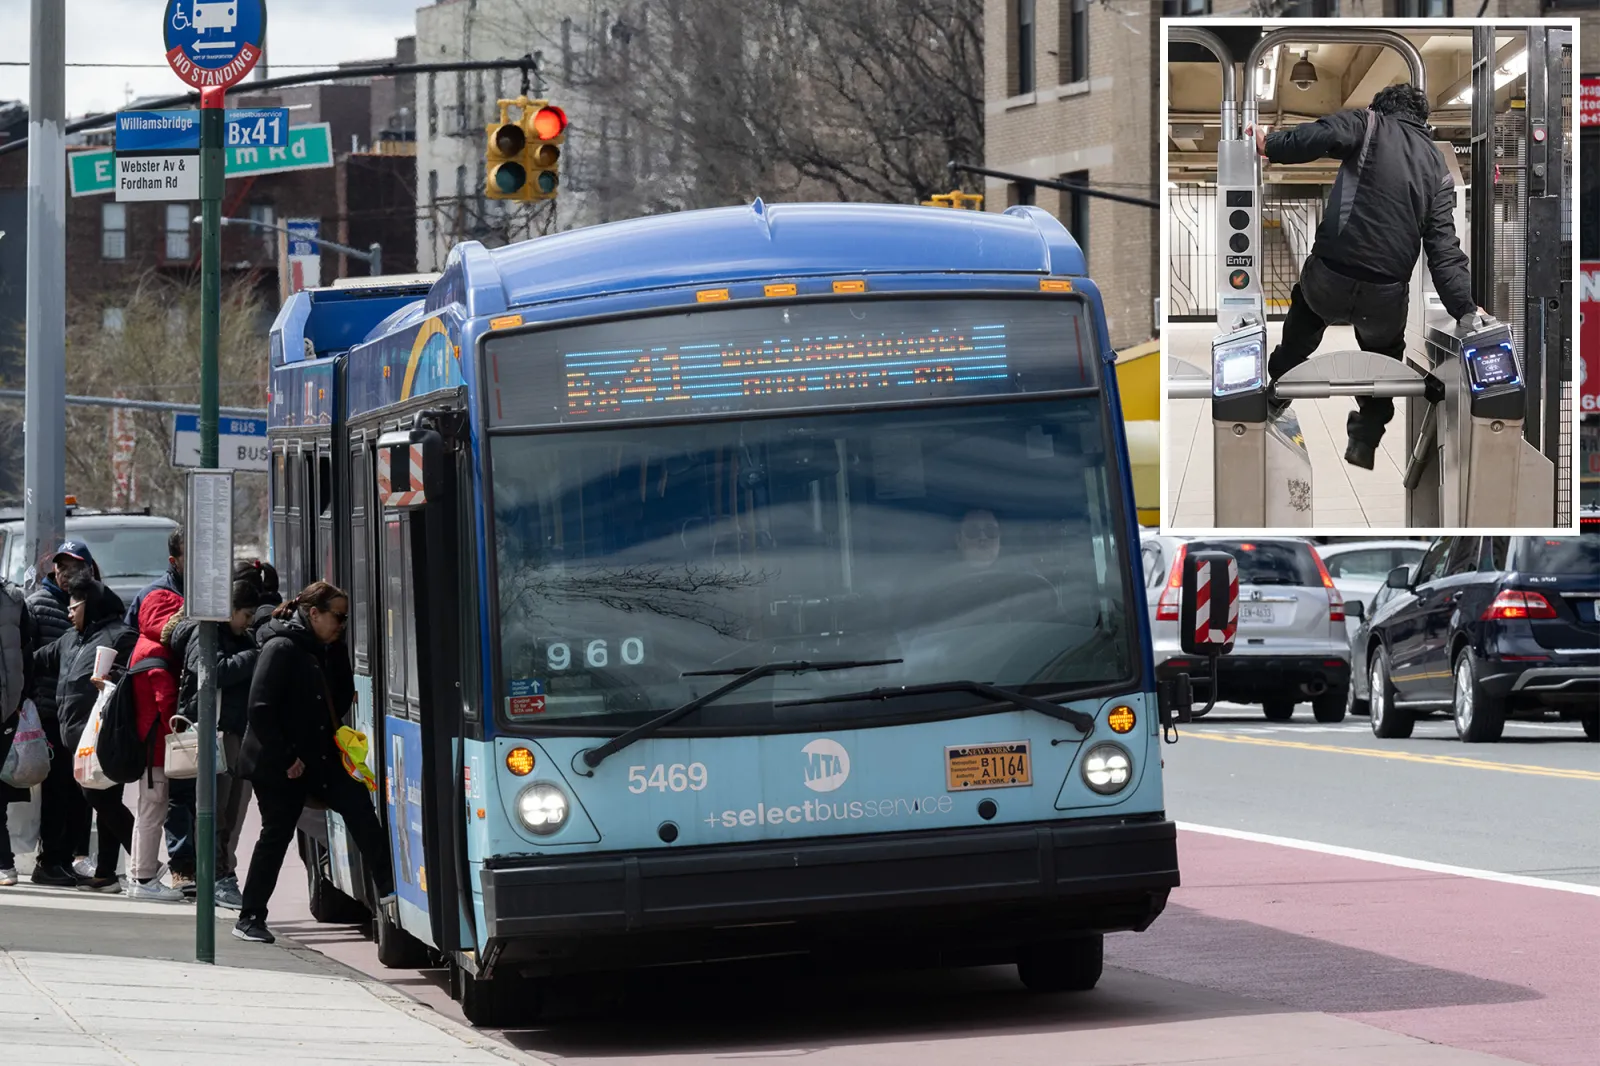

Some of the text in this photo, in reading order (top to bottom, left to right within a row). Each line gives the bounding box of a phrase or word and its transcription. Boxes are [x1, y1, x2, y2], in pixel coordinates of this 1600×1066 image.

[173, 48, 253, 86] NO STANDING
[120, 115, 193, 131] Williamsbridge
[228, 117, 280, 145] Bx41
[94, 160, 112, 182] E
[121, 158, 186, 173] Webster Av &
[121, 175, 178, 190] Fordham Rd
[1227, 256, 1252, 267] Entry
[230, 421, 256, 433] BUS
[237, 446, 268, 461] BUS
[967, 746, 1009, 756] NEW YORK
[801, 750, 844, 783] MTA
[991, 755, 1024, 777] 1164
[628, 762, 708, 794] 5469
